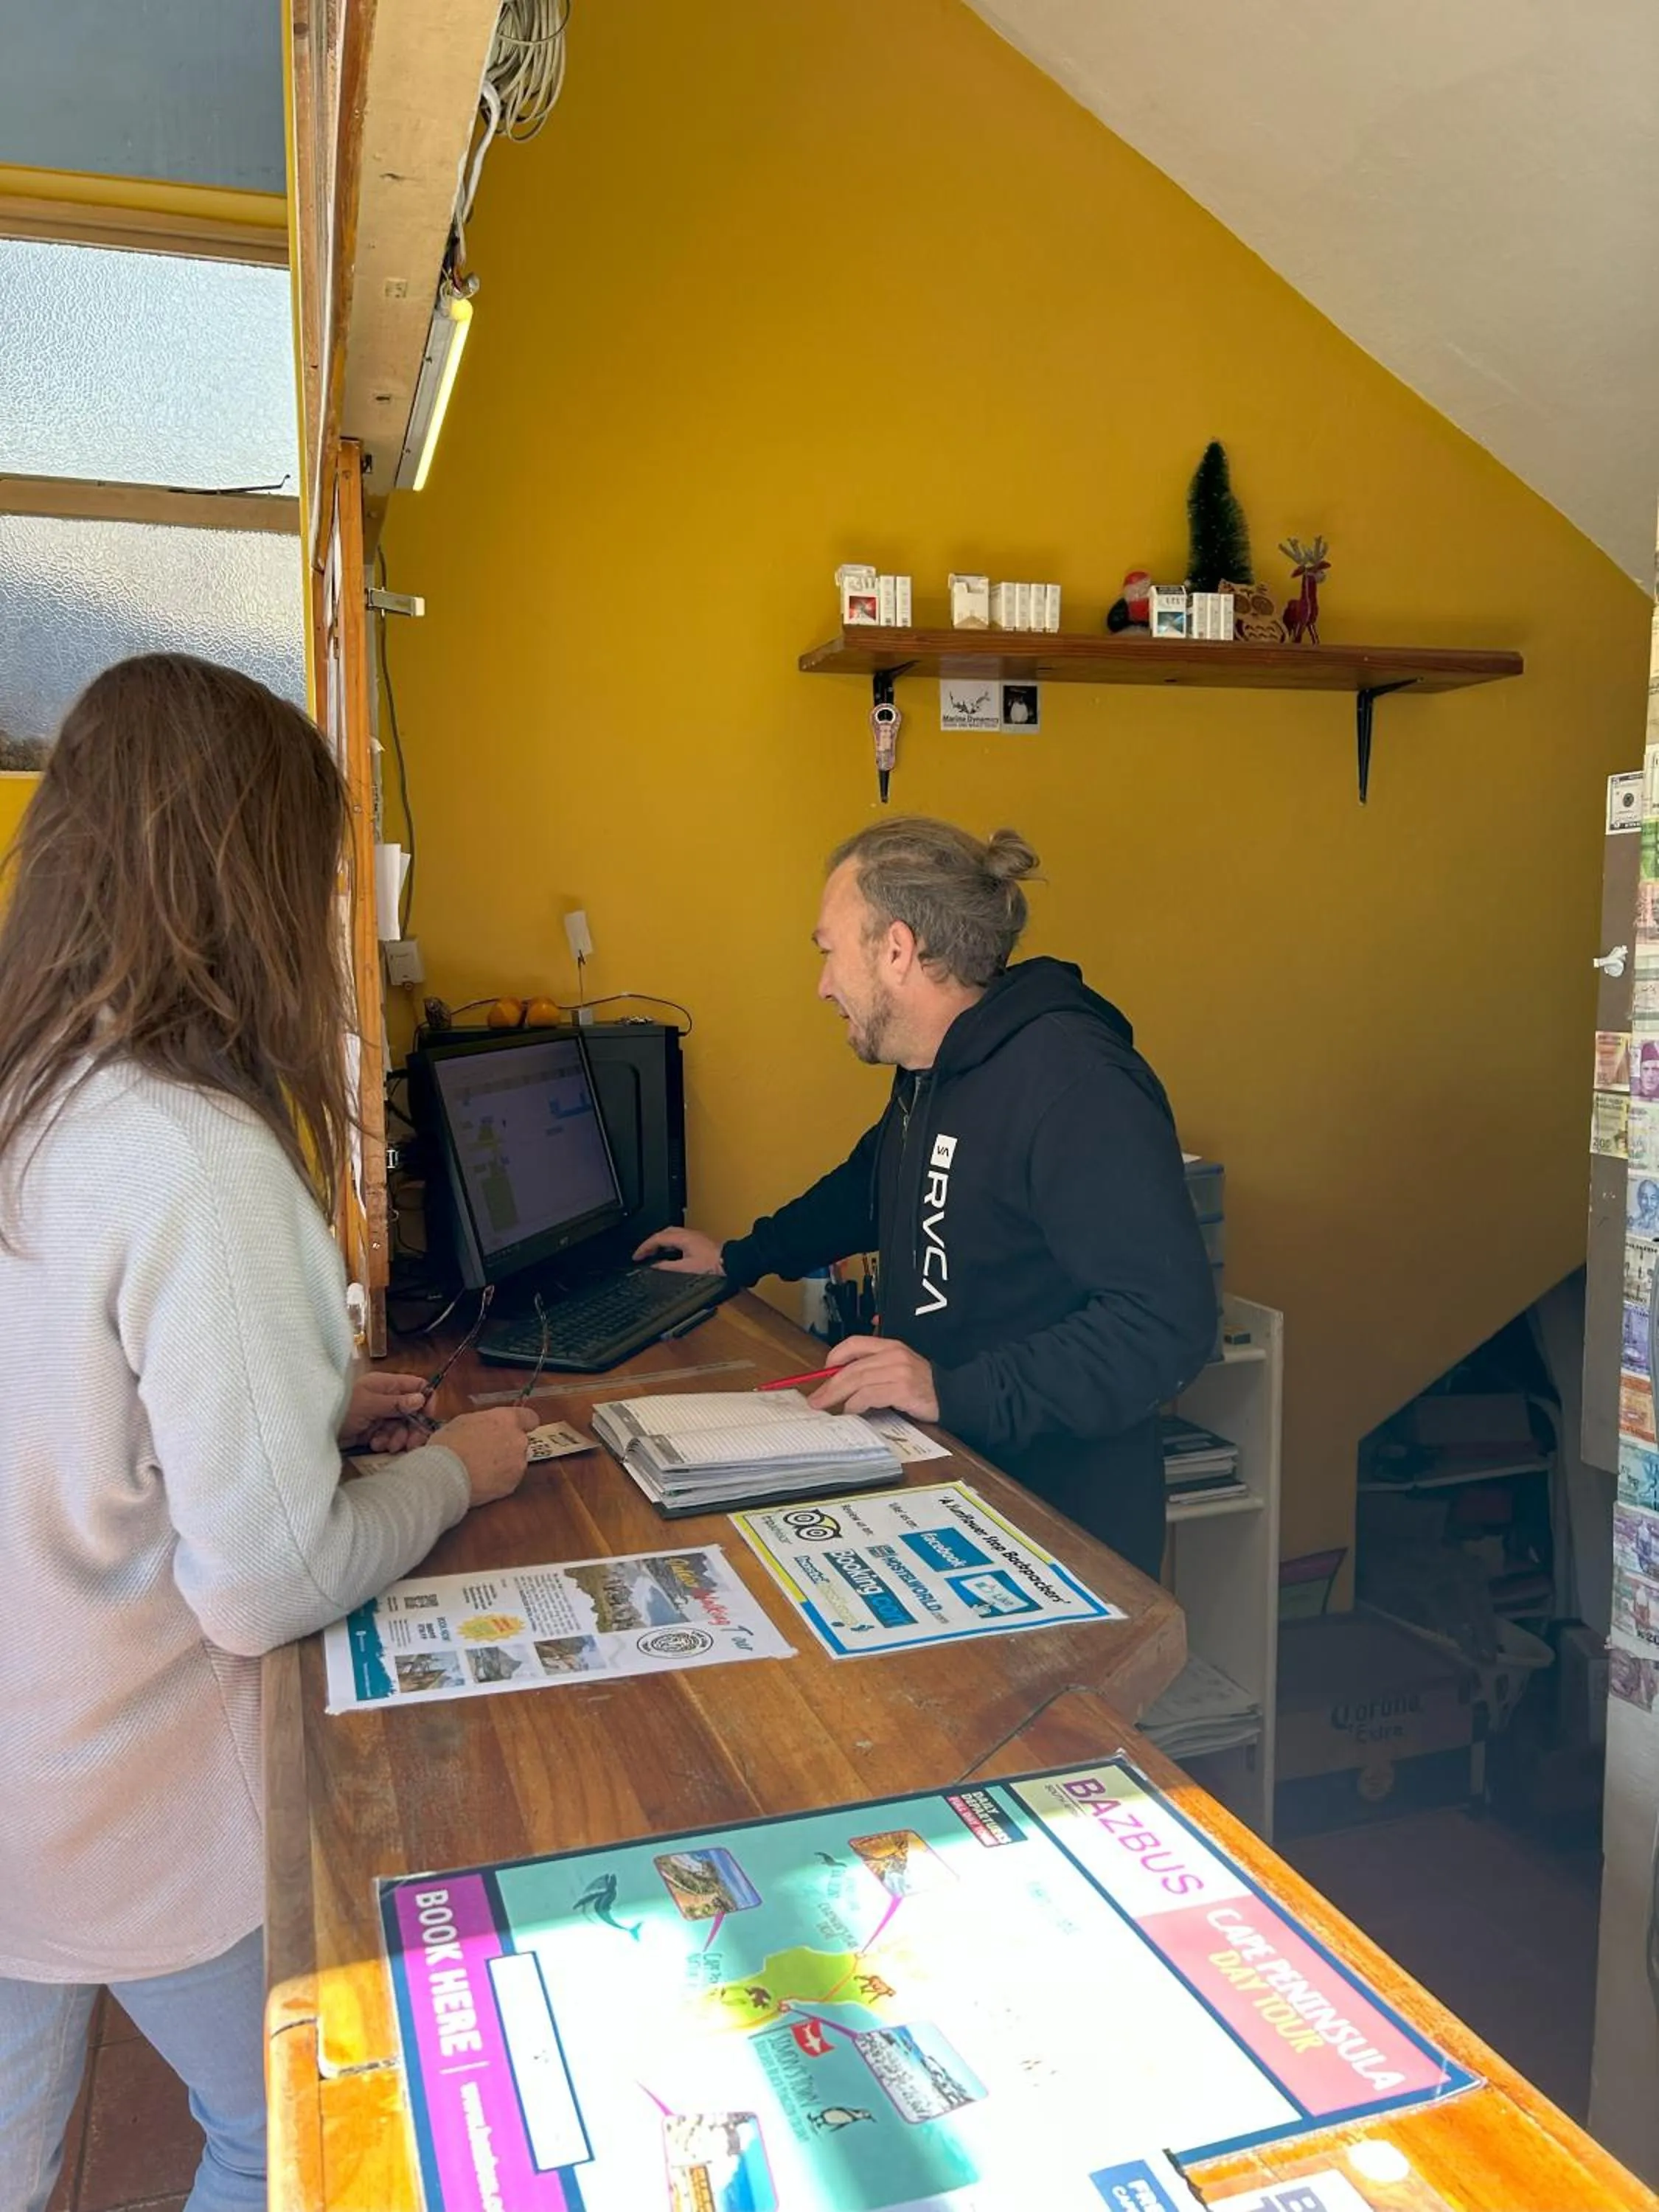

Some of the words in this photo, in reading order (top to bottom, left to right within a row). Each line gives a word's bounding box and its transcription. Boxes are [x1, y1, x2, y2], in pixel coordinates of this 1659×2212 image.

[942, 714, 967, 724] Marine
[967, 714, 999, 725] Dynamics
[915, 1170, 949, 1315] RVCA
[922, 1532, 967, 1568] facebook
[980, 1536, 1009, 1553] Stop
[827, 1548, 914, 1625] Booking.com
[961, 1793, 1012, 1843] DEPARTURES
[971, 1792, 1000, 1814] DAILY
[1063, 1778, 1204, 1895] BAZBUS
[415, 1889, 455, 1965] BOOK
[429, 1967, 482, 2058] HERE
[1206, 1908, 1276, 1965] CAPE
[1256, 1954, 1405, 2092] PENINSULA
[1208, 1950, 1269, 1992] DAY
[1251, 1989, 1326, 2054] TOUR
